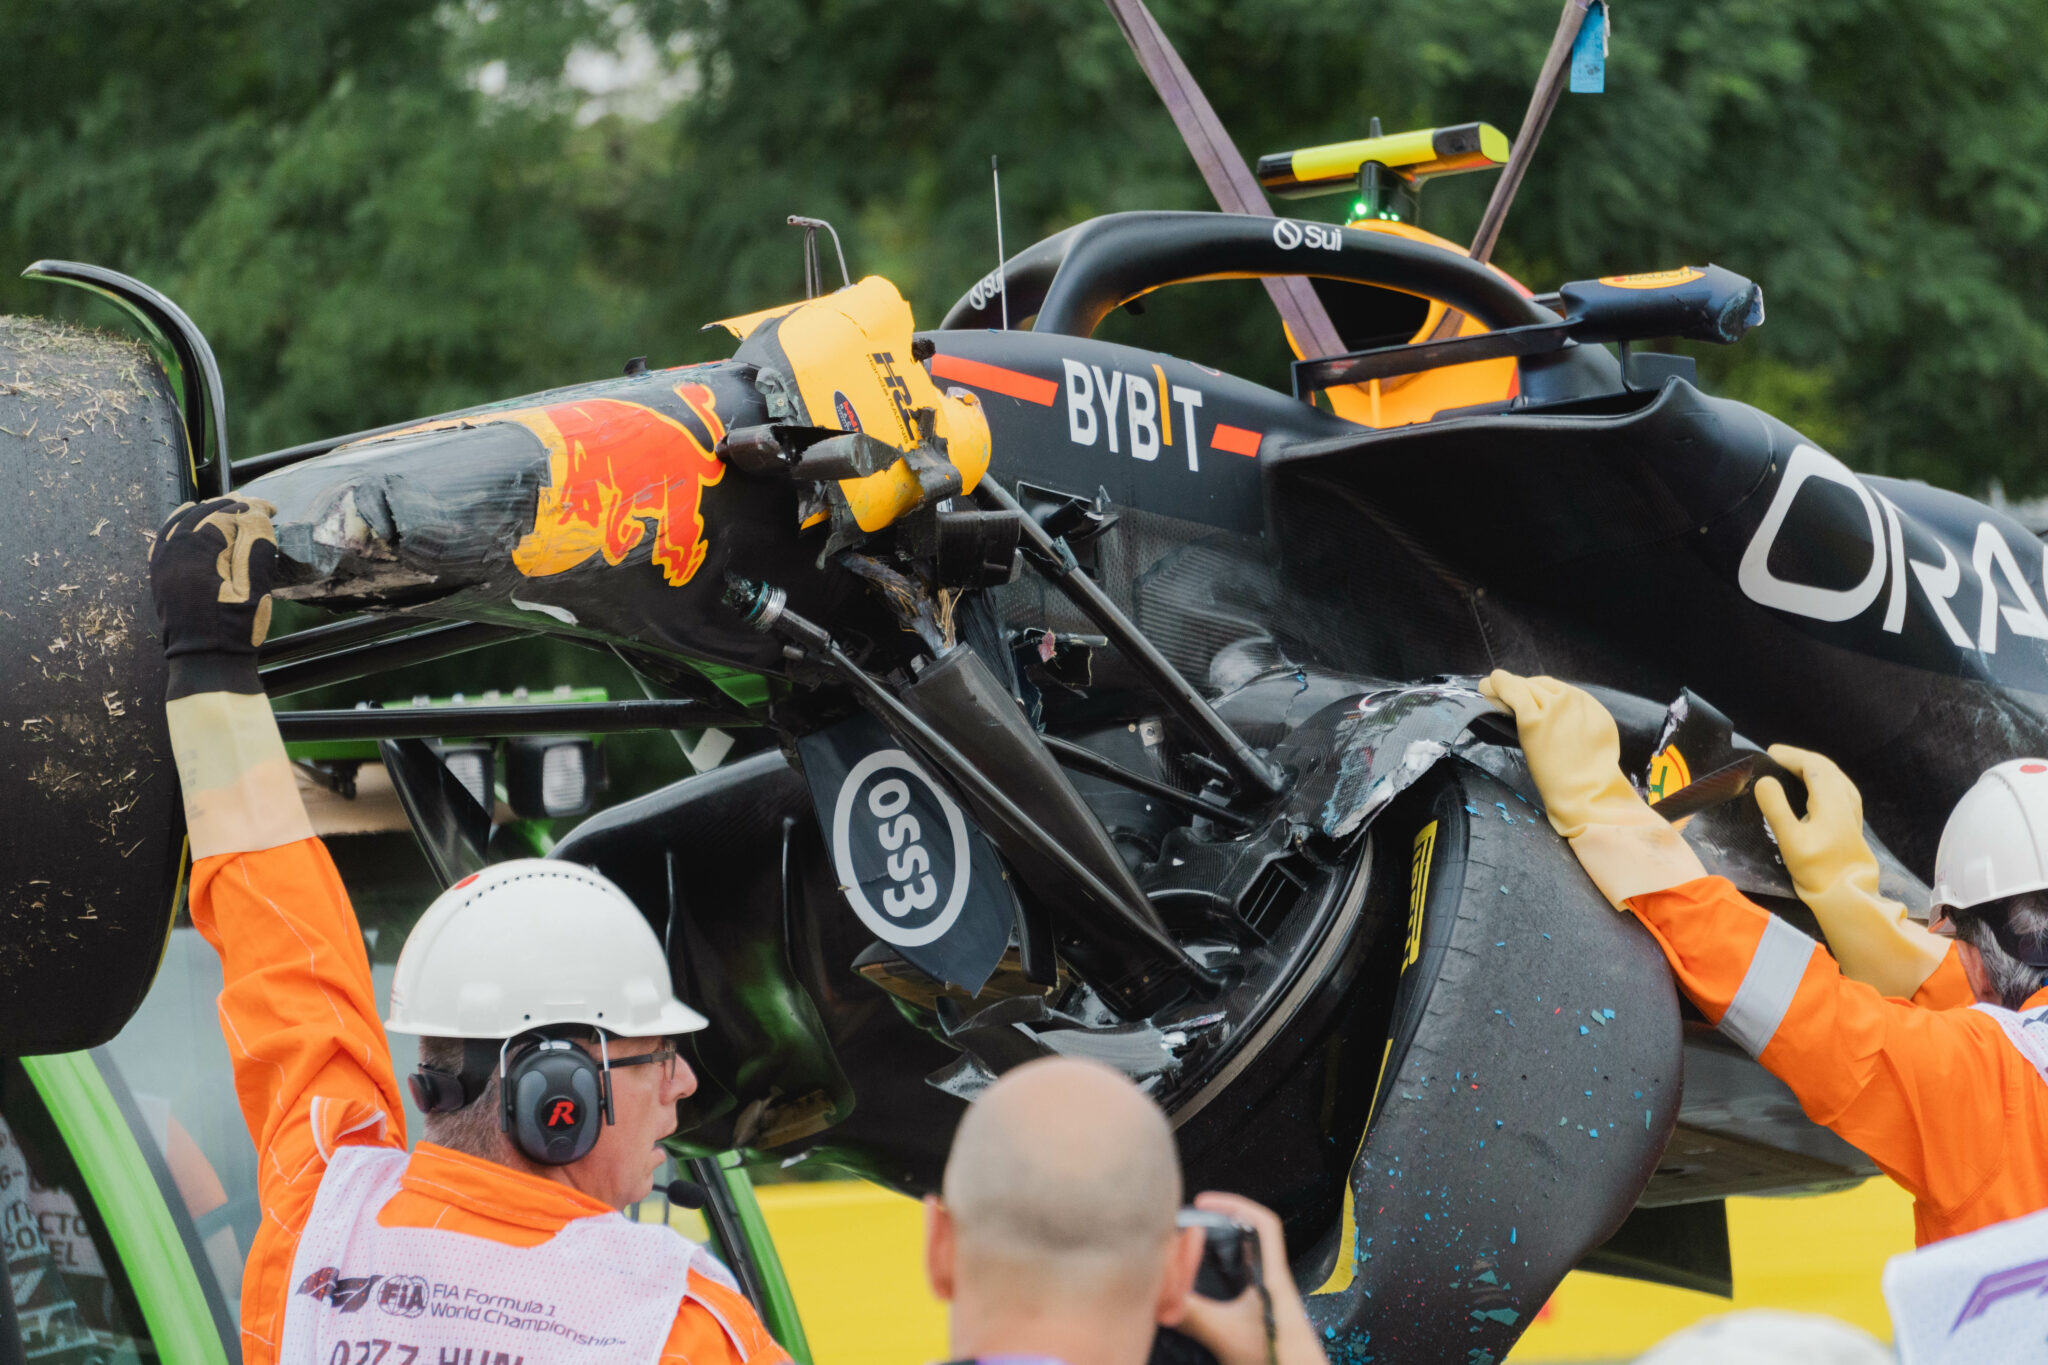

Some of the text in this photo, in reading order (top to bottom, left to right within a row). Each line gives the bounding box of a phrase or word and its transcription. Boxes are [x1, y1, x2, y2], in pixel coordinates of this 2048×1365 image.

[1305, 225, 1342, 251] Sui
[1062, 357, 1202, 472] BYBIT
[1738, 443, 2048, 654] ORA
[431, 1302, 482, 1321] World
[432, 1283, 556, 1318] FIA Formula 1
